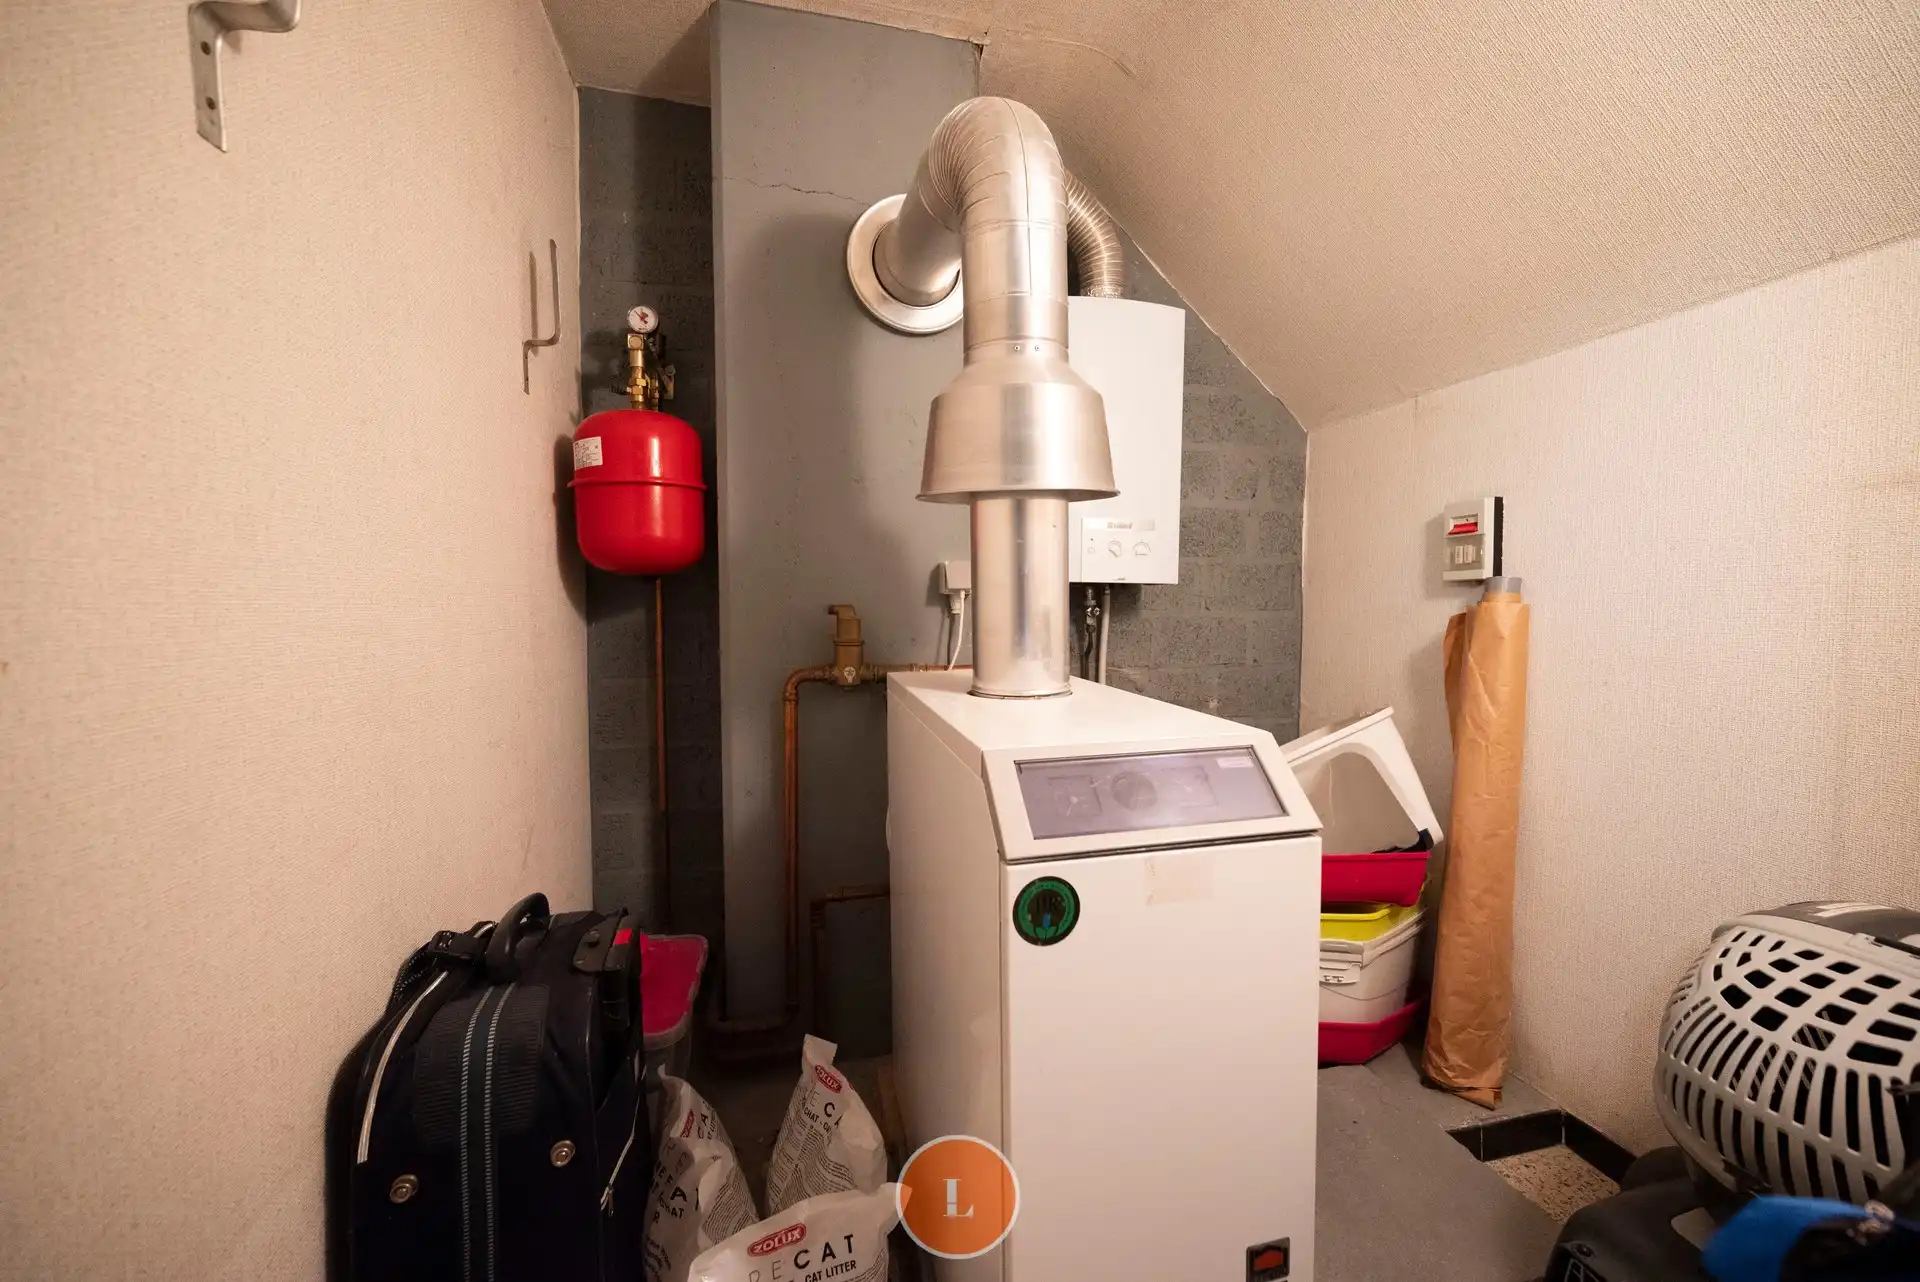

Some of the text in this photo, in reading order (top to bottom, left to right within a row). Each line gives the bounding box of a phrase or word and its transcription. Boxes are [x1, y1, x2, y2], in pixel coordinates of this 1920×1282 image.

[753, 1228, 802, 1254] ZOLUX
[805, 1270, 822, 1282] CAT
[825, 1260, 857, 1278] LITTER
